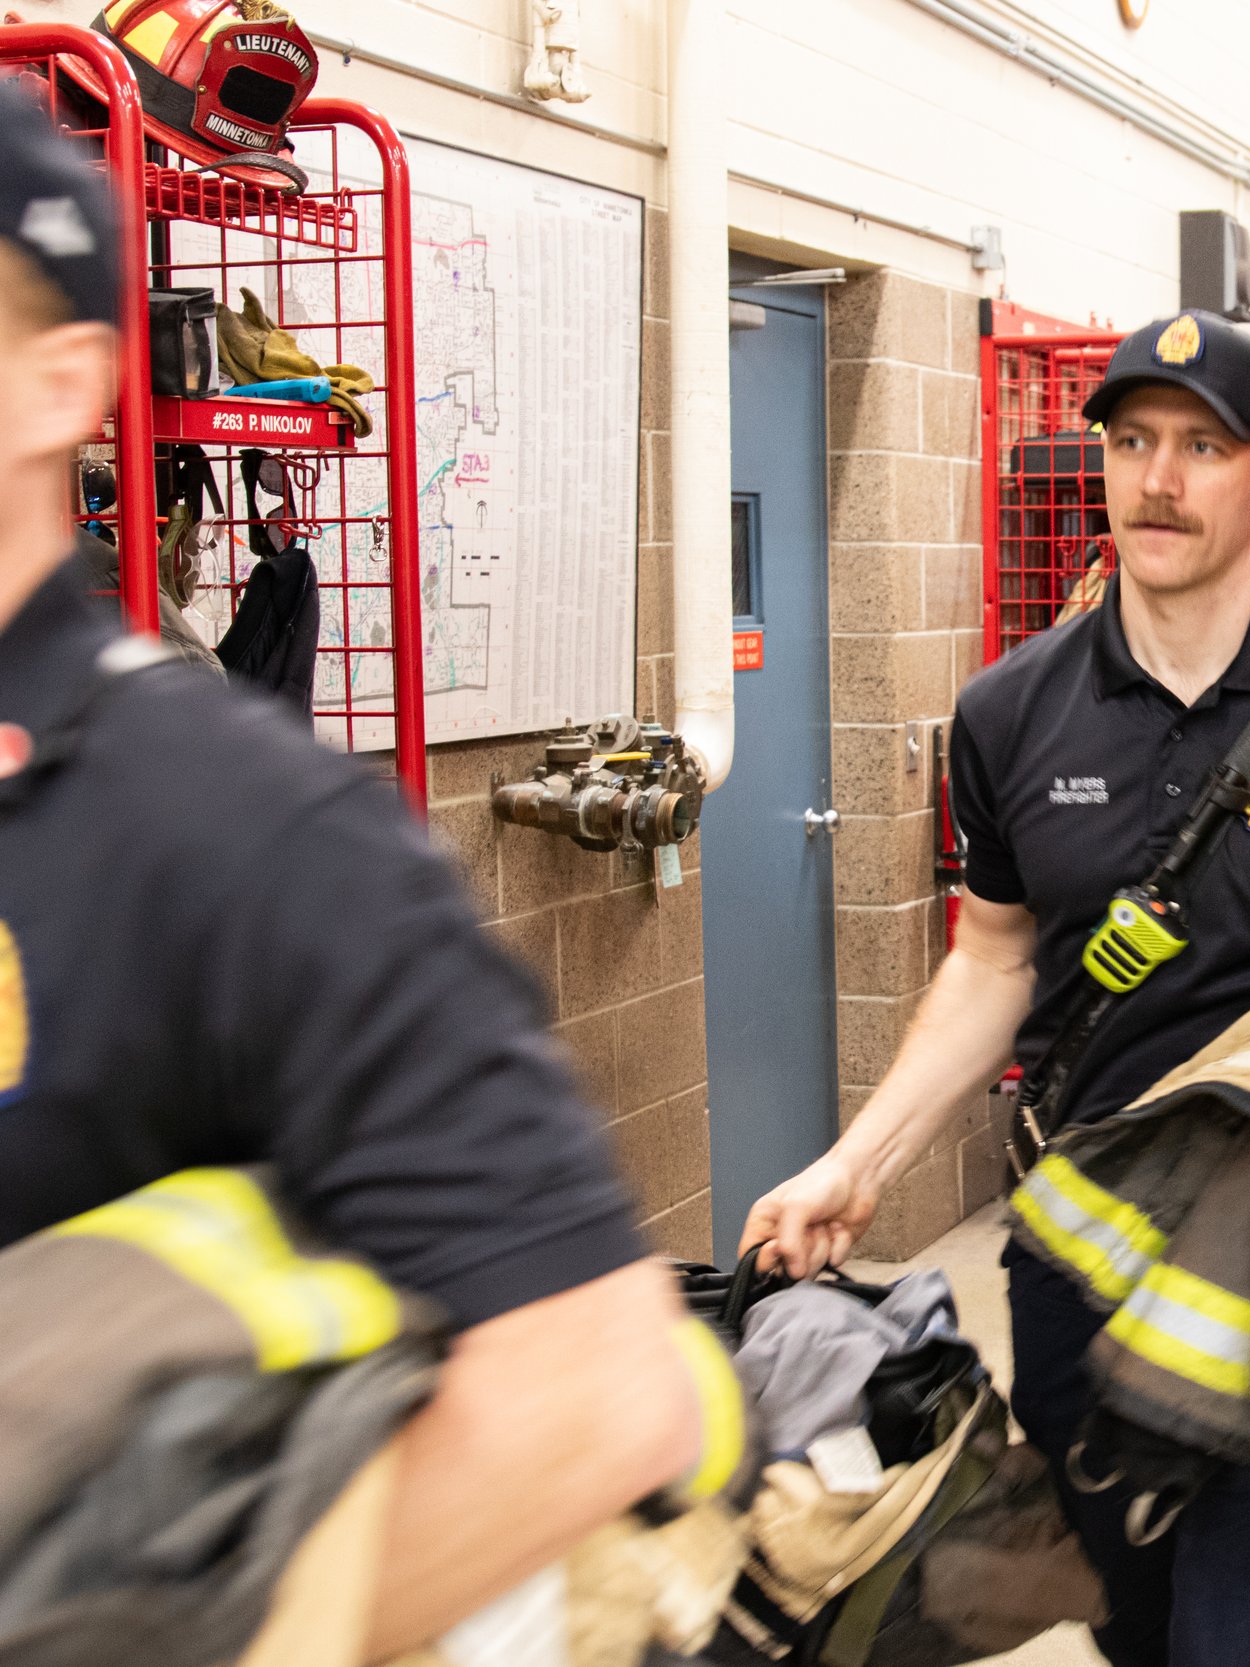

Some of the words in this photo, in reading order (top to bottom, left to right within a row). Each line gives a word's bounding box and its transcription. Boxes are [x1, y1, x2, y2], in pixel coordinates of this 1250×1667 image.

[236, 34, 310, 73] LIEUTENANT
[205, 113, 271, 148] MINNETONKA
[212, 411, 243, 430] #263
[249, 413, 259, 432] P.
[261, 415, 312, 434] NIKOLOV
[1048, 789, 1109, 804] FIREFIGHTER
